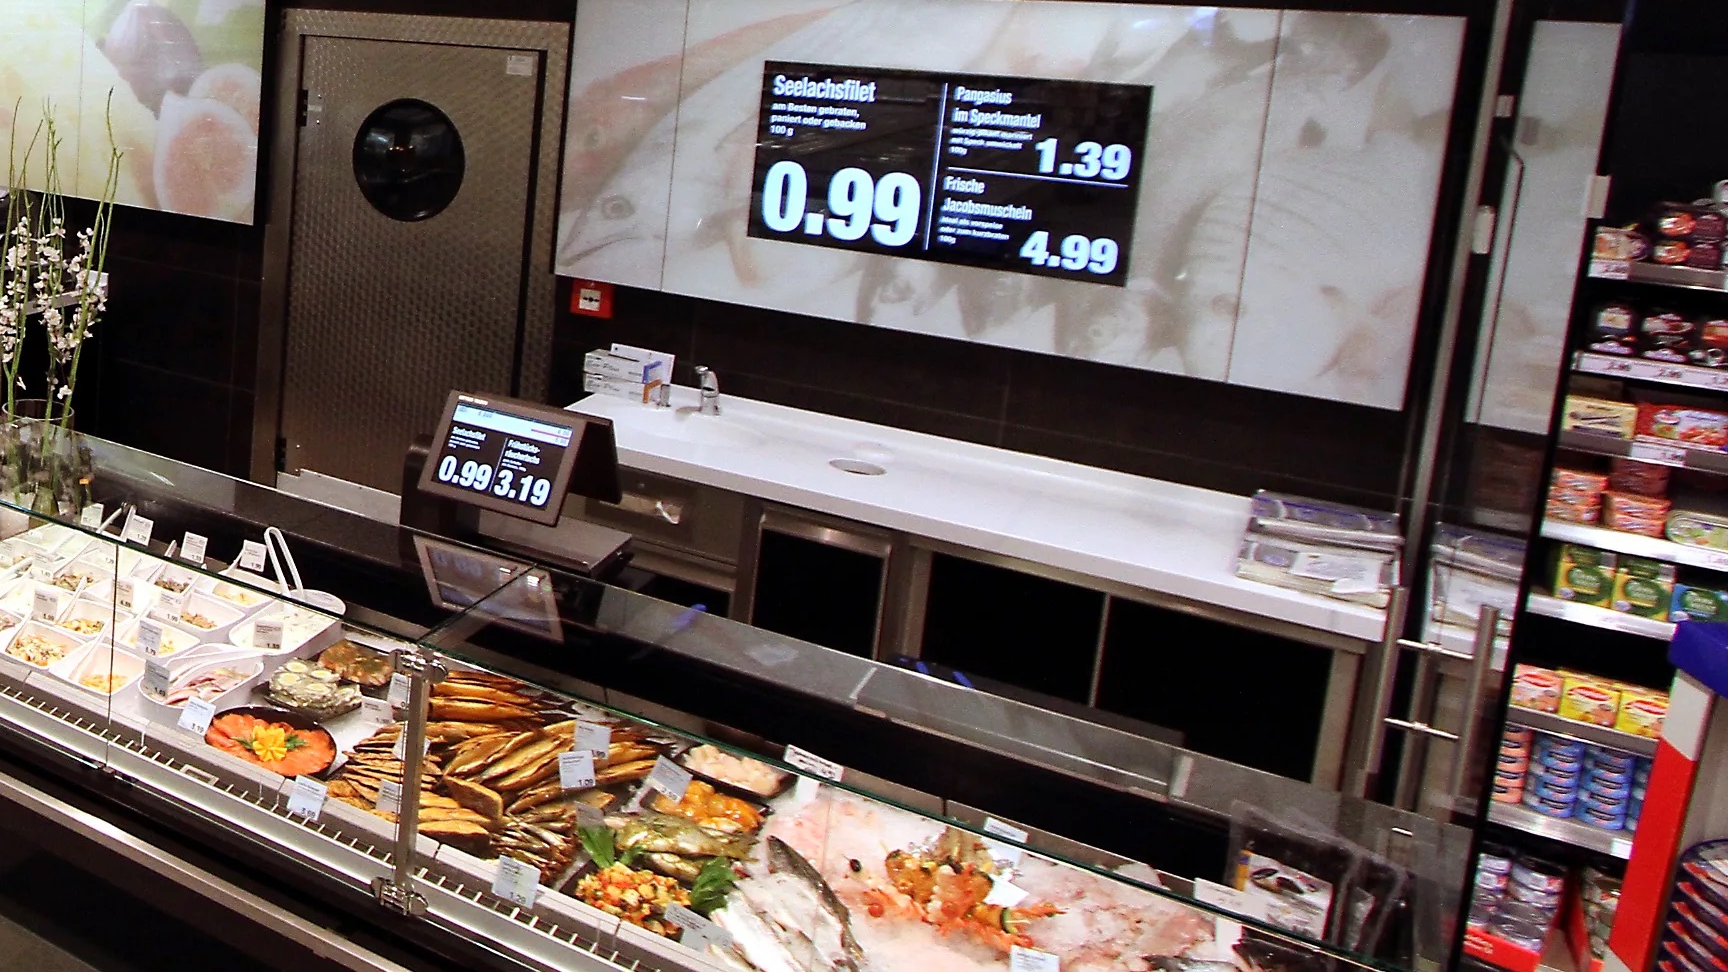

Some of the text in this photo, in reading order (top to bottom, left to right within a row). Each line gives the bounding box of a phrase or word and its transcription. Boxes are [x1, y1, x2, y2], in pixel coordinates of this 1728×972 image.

[773, 74, 876, 102] Seelachsfilet
[954, 86, 1012, 106] Pangasius
[770, 114, 866, 130] paniert oder gebacken
[770, 125, 786, 134] 100
[952, 107, 1041, 128] im Speckmantel
[1034, 138, 1131, 181] 1.39
[943, 176, 985, 194] Frische
[761, 160, 921, 247] 0.99
[941, 197, 1032, 220] Jacobsmuscheln
[1019, 231, 1119, 274] 4.99
[438, 455, 492, 491] 0.99
[494, 470, 551, 506] 3.19
